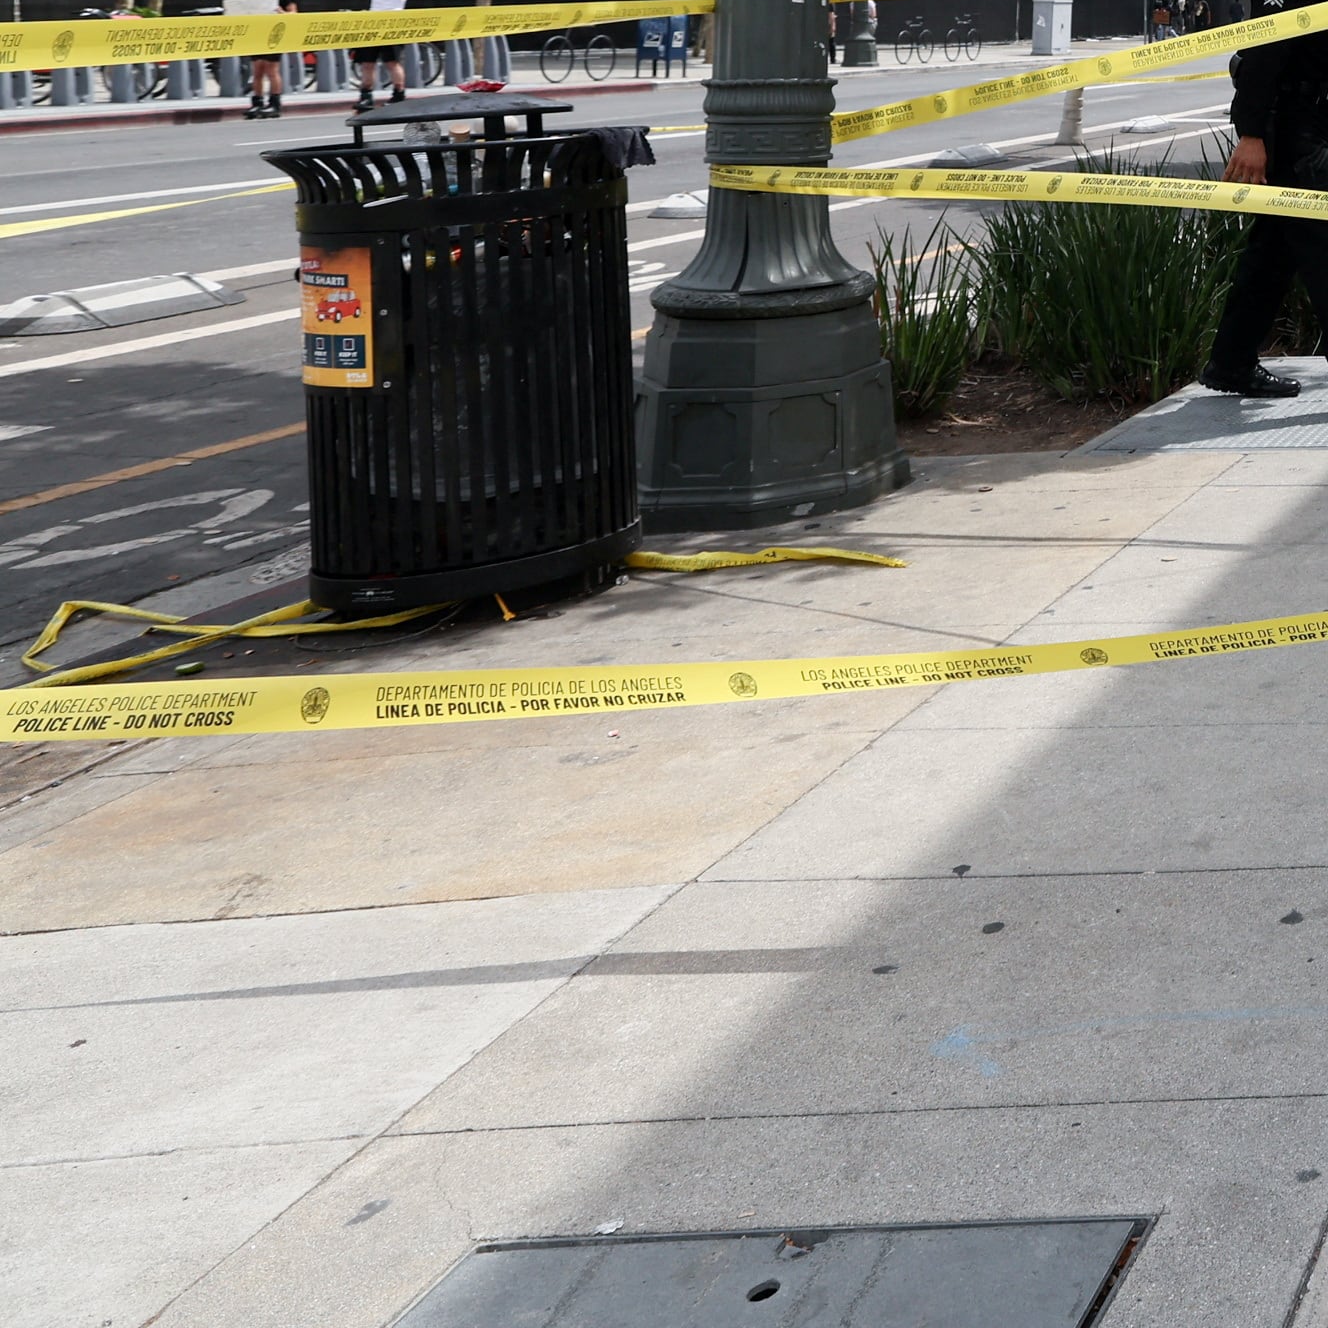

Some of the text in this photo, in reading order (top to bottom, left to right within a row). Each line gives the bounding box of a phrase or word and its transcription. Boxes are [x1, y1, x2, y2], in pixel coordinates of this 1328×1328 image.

[1264, 197, 1313, 212] DEPARTMENT
[1278, 190, 1305, 200] CROSS
[1303, 192, 1321, 201] NOT
[1149, 631, 1254, 651] DEPARTAMENTO
[1256, 627, 1276, 639] DE
[1154, 647, 1197, 658] LINEA
[1199, 644, 1218, 653] DE
[1221, 638, 1276, 651] POLICIA
[1289, 632, 1318, 642] POR
[800, 654, 1033, 682] LOS ANGELES POLICE DEPARTMENT
[821, 666, 1024, 690] POLICE LINE DO NOT CROSS
[376, 676, 683, 702] DEPARTAMENTO DE POLICIA DE LOS ANGELES
[6, 691, 257, 717] LOS ANGELES POLICE DEPARTMENT
[376, 703, 421, 719] LINEA
[424, 702, 444, 717] DE
[447, 700, 506, 716] POLICIA
[520, 698, 551, 712] POR
[553, 696, 600, 710] FAVOR
[603, 694, 625, 707] NO
[627, 691, 686, 705] CRUZAR
[12, 716, 73, 733] POLICE
[71, 715, 112, 732] LINE
[122, 713, 147, 730] DO
[147, 712, 183, 729] NOT
[183, 710, 235, 728] CROSS
